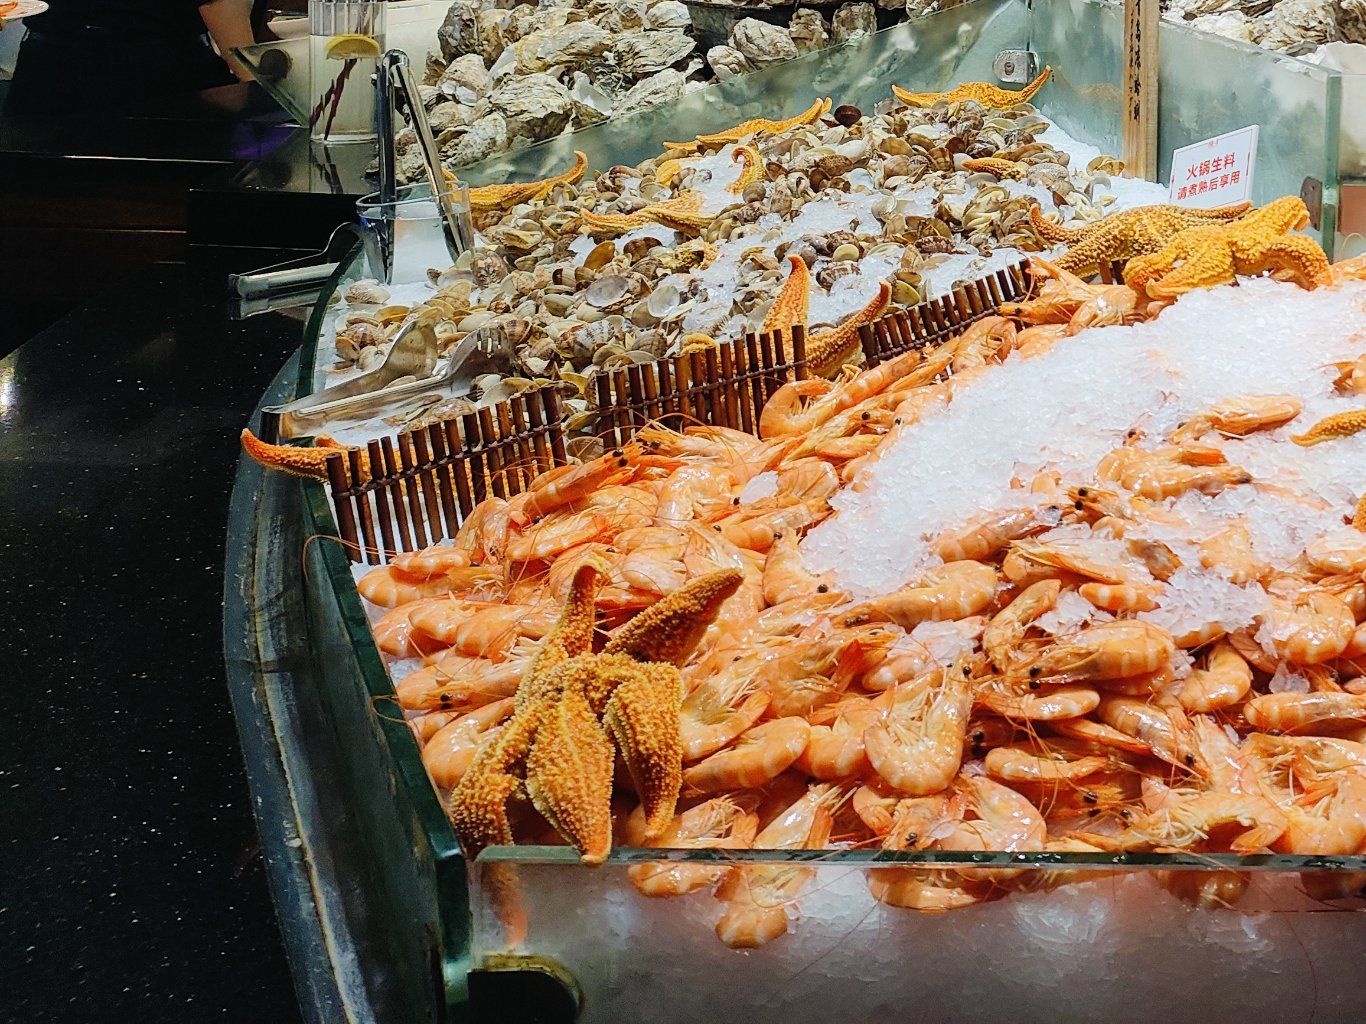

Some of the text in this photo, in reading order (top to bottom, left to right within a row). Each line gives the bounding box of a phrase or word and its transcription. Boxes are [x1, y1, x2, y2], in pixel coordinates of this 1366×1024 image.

[1186, 152, 1236, 181] 火锅生料
[1177, 170, 1241, 200] 请煮熟后享用
